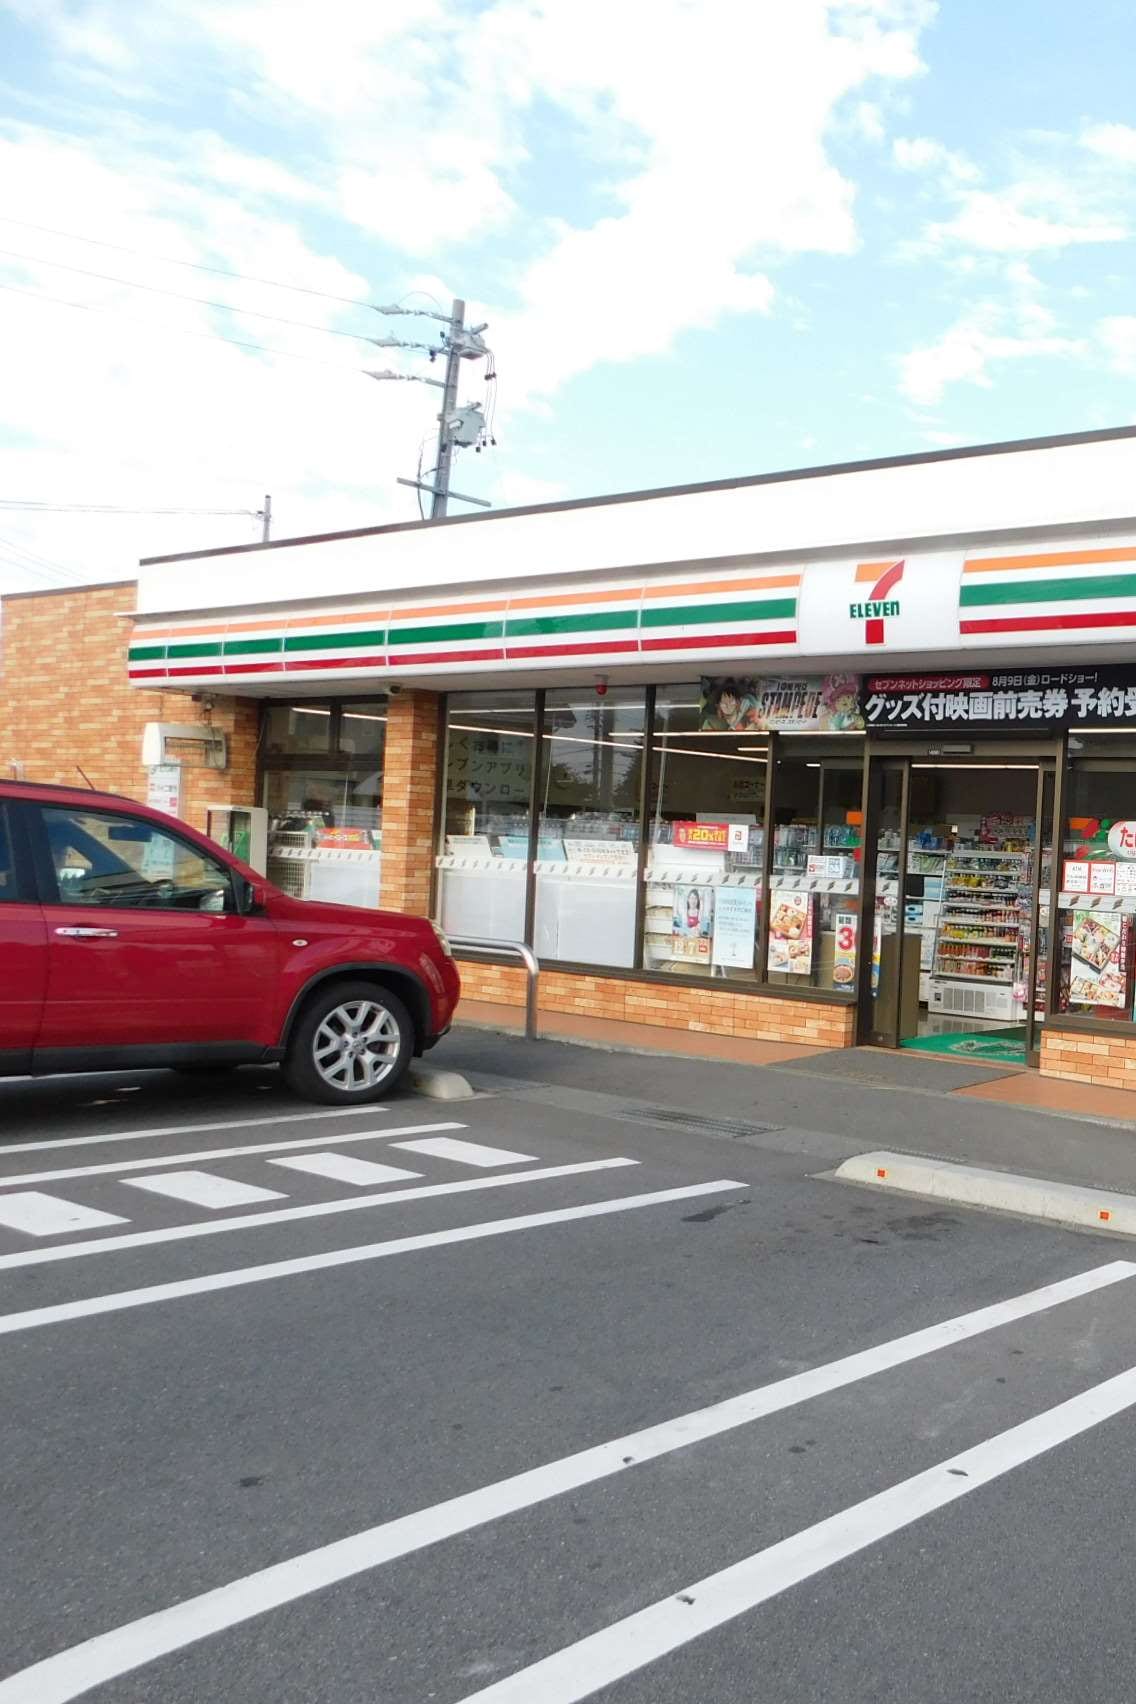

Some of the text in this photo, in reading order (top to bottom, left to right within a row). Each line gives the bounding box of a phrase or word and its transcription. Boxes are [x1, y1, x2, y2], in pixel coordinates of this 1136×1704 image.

[865, 688, 1069, 721] グッズ付映画前売券
